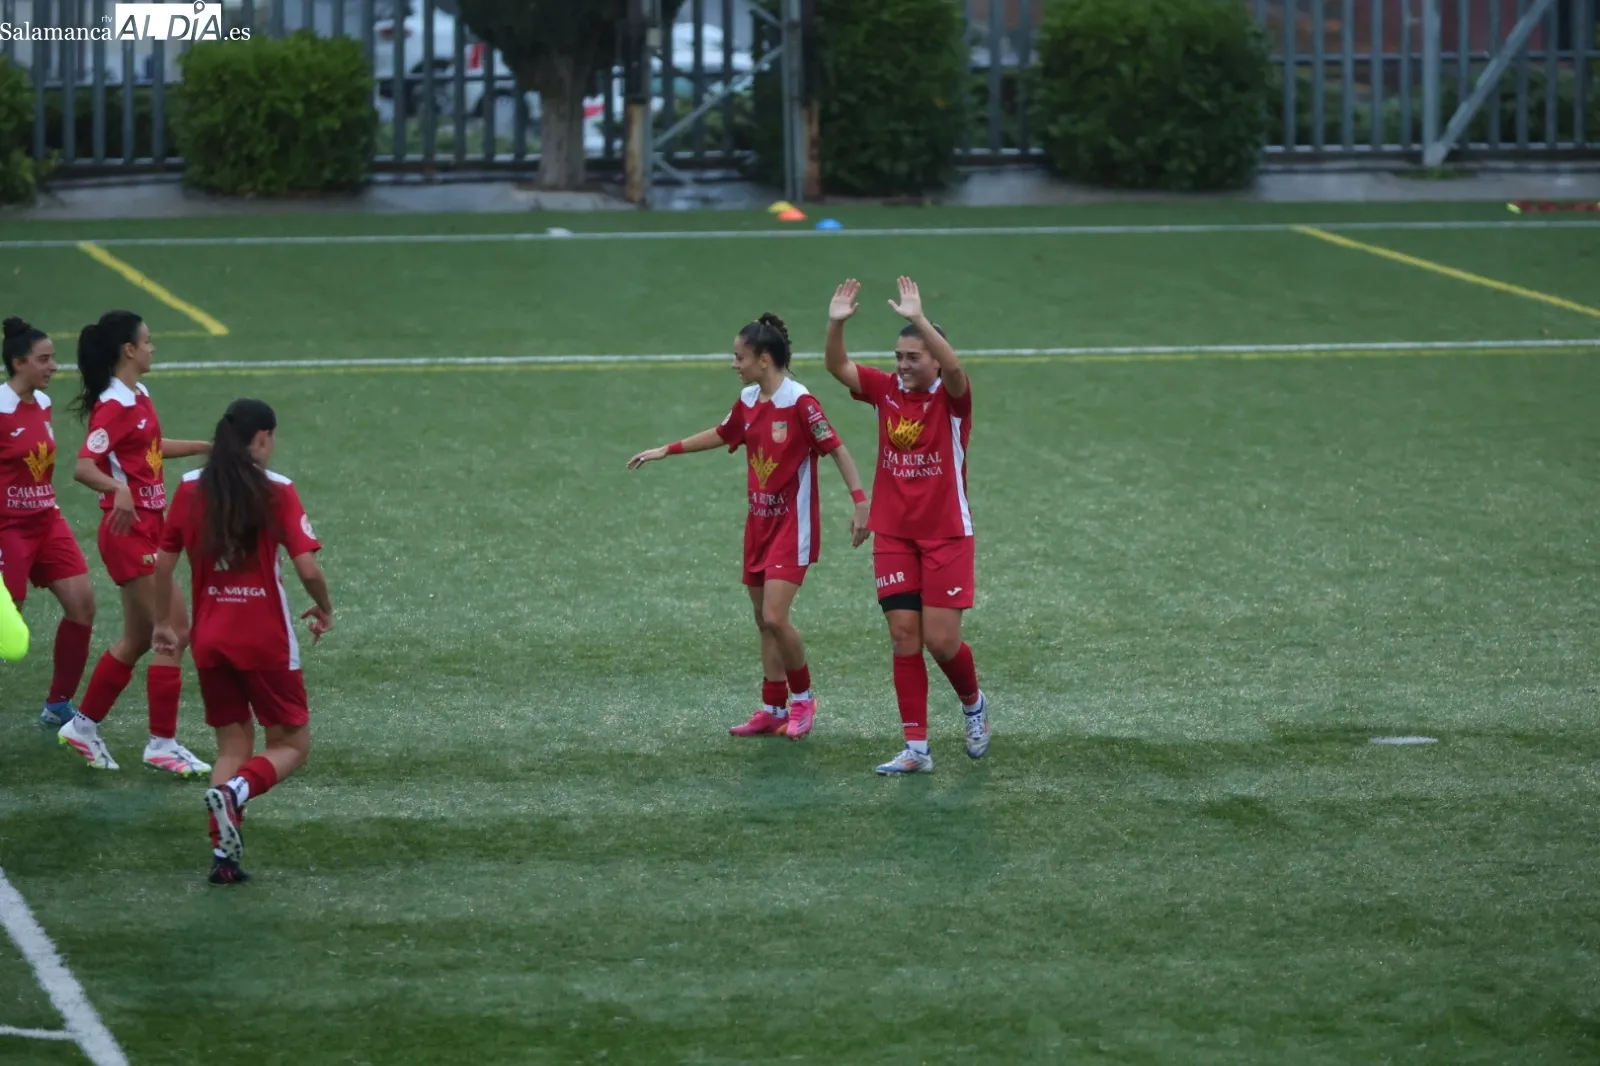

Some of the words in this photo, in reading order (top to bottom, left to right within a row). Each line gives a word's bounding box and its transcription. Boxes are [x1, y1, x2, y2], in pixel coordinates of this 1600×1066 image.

[902, 451, 942, 466] RURAL
[893, 466, 943, 478] LAMANCA
[7, 485, 35, 499] CAJA
[224, 586, 267, 597] NAVEGA
